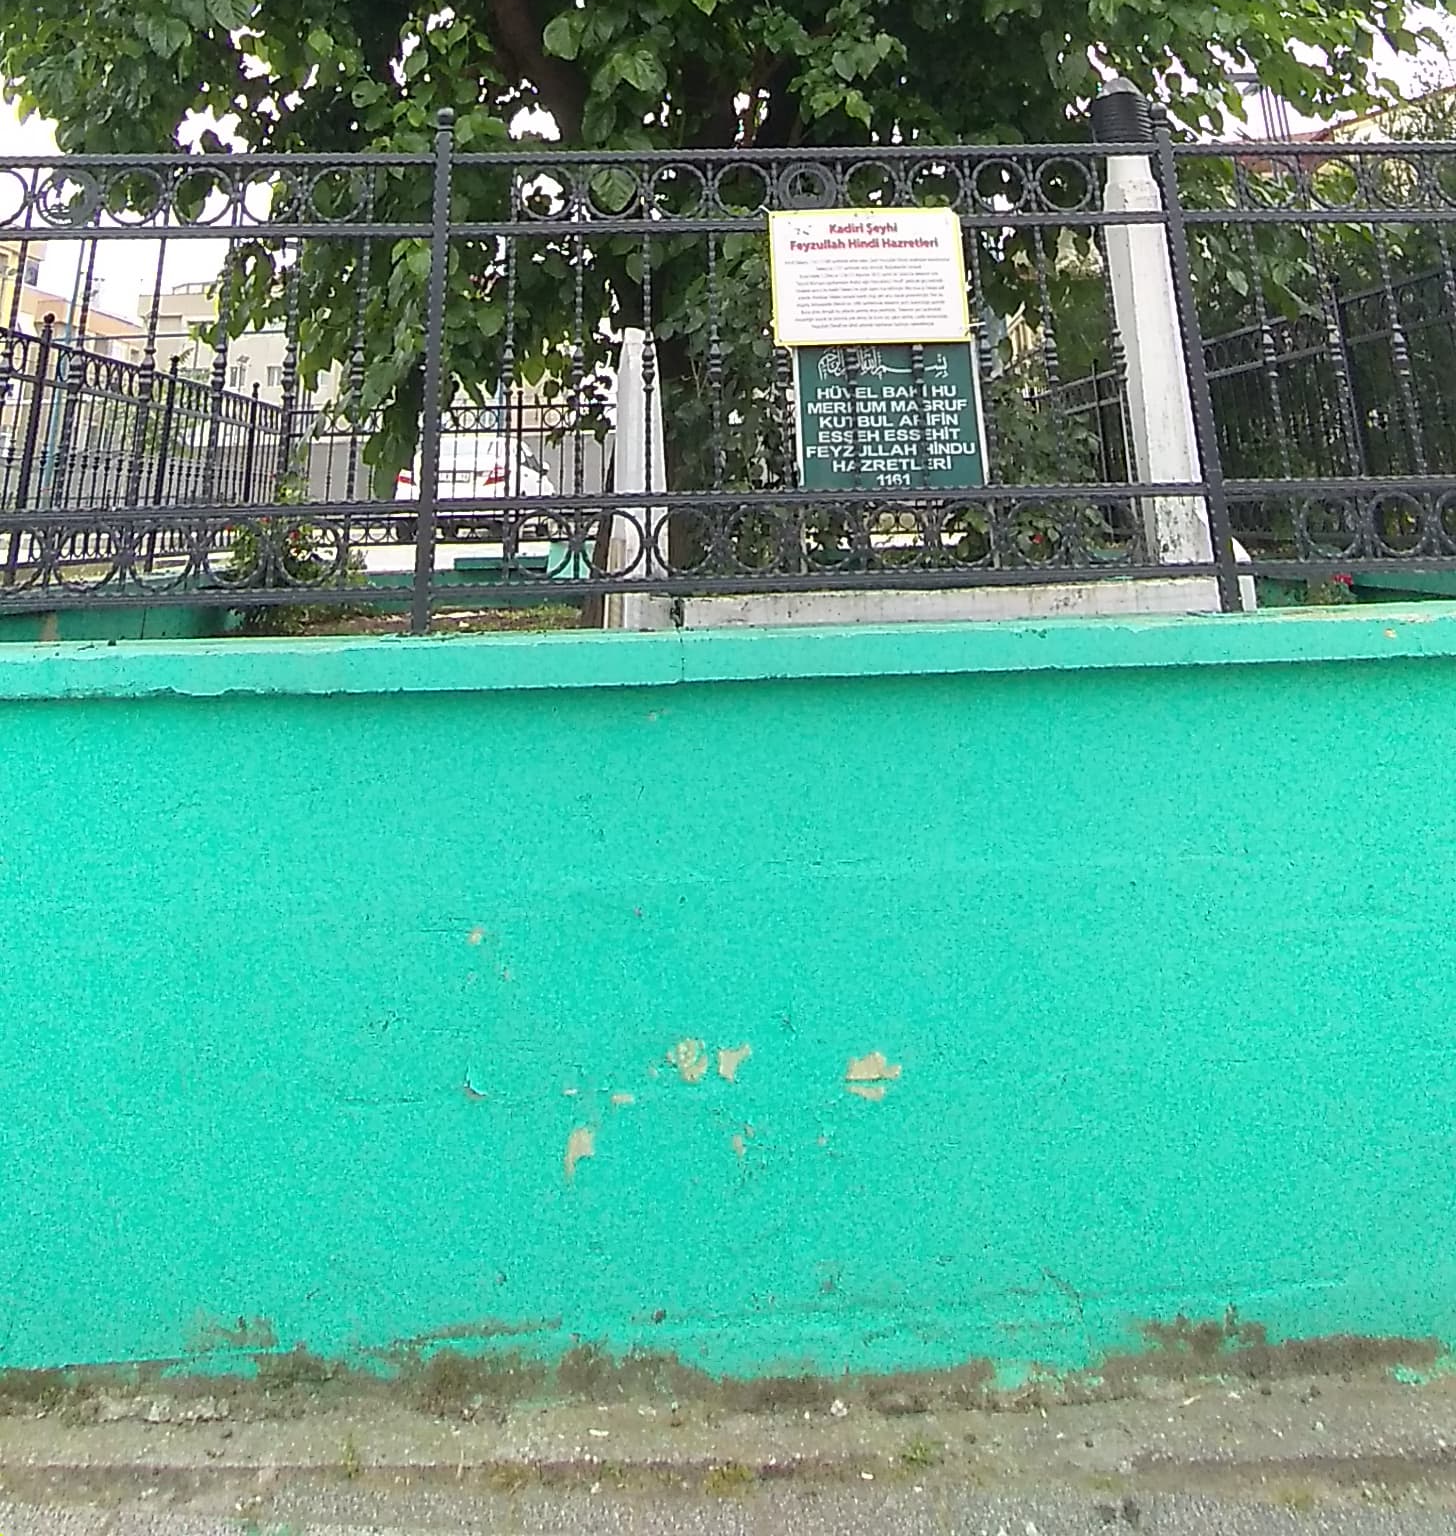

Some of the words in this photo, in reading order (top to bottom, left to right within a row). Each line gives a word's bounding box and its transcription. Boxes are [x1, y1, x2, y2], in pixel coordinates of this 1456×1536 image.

[866, 222, 898, 235] Şeyhi
[790, 239, 846, 252] Feyzullah
[881, 236, 939, 249] Hazretleri
[932, 385, 957, 398] HU
[876, 473, 912, 486] 1161
